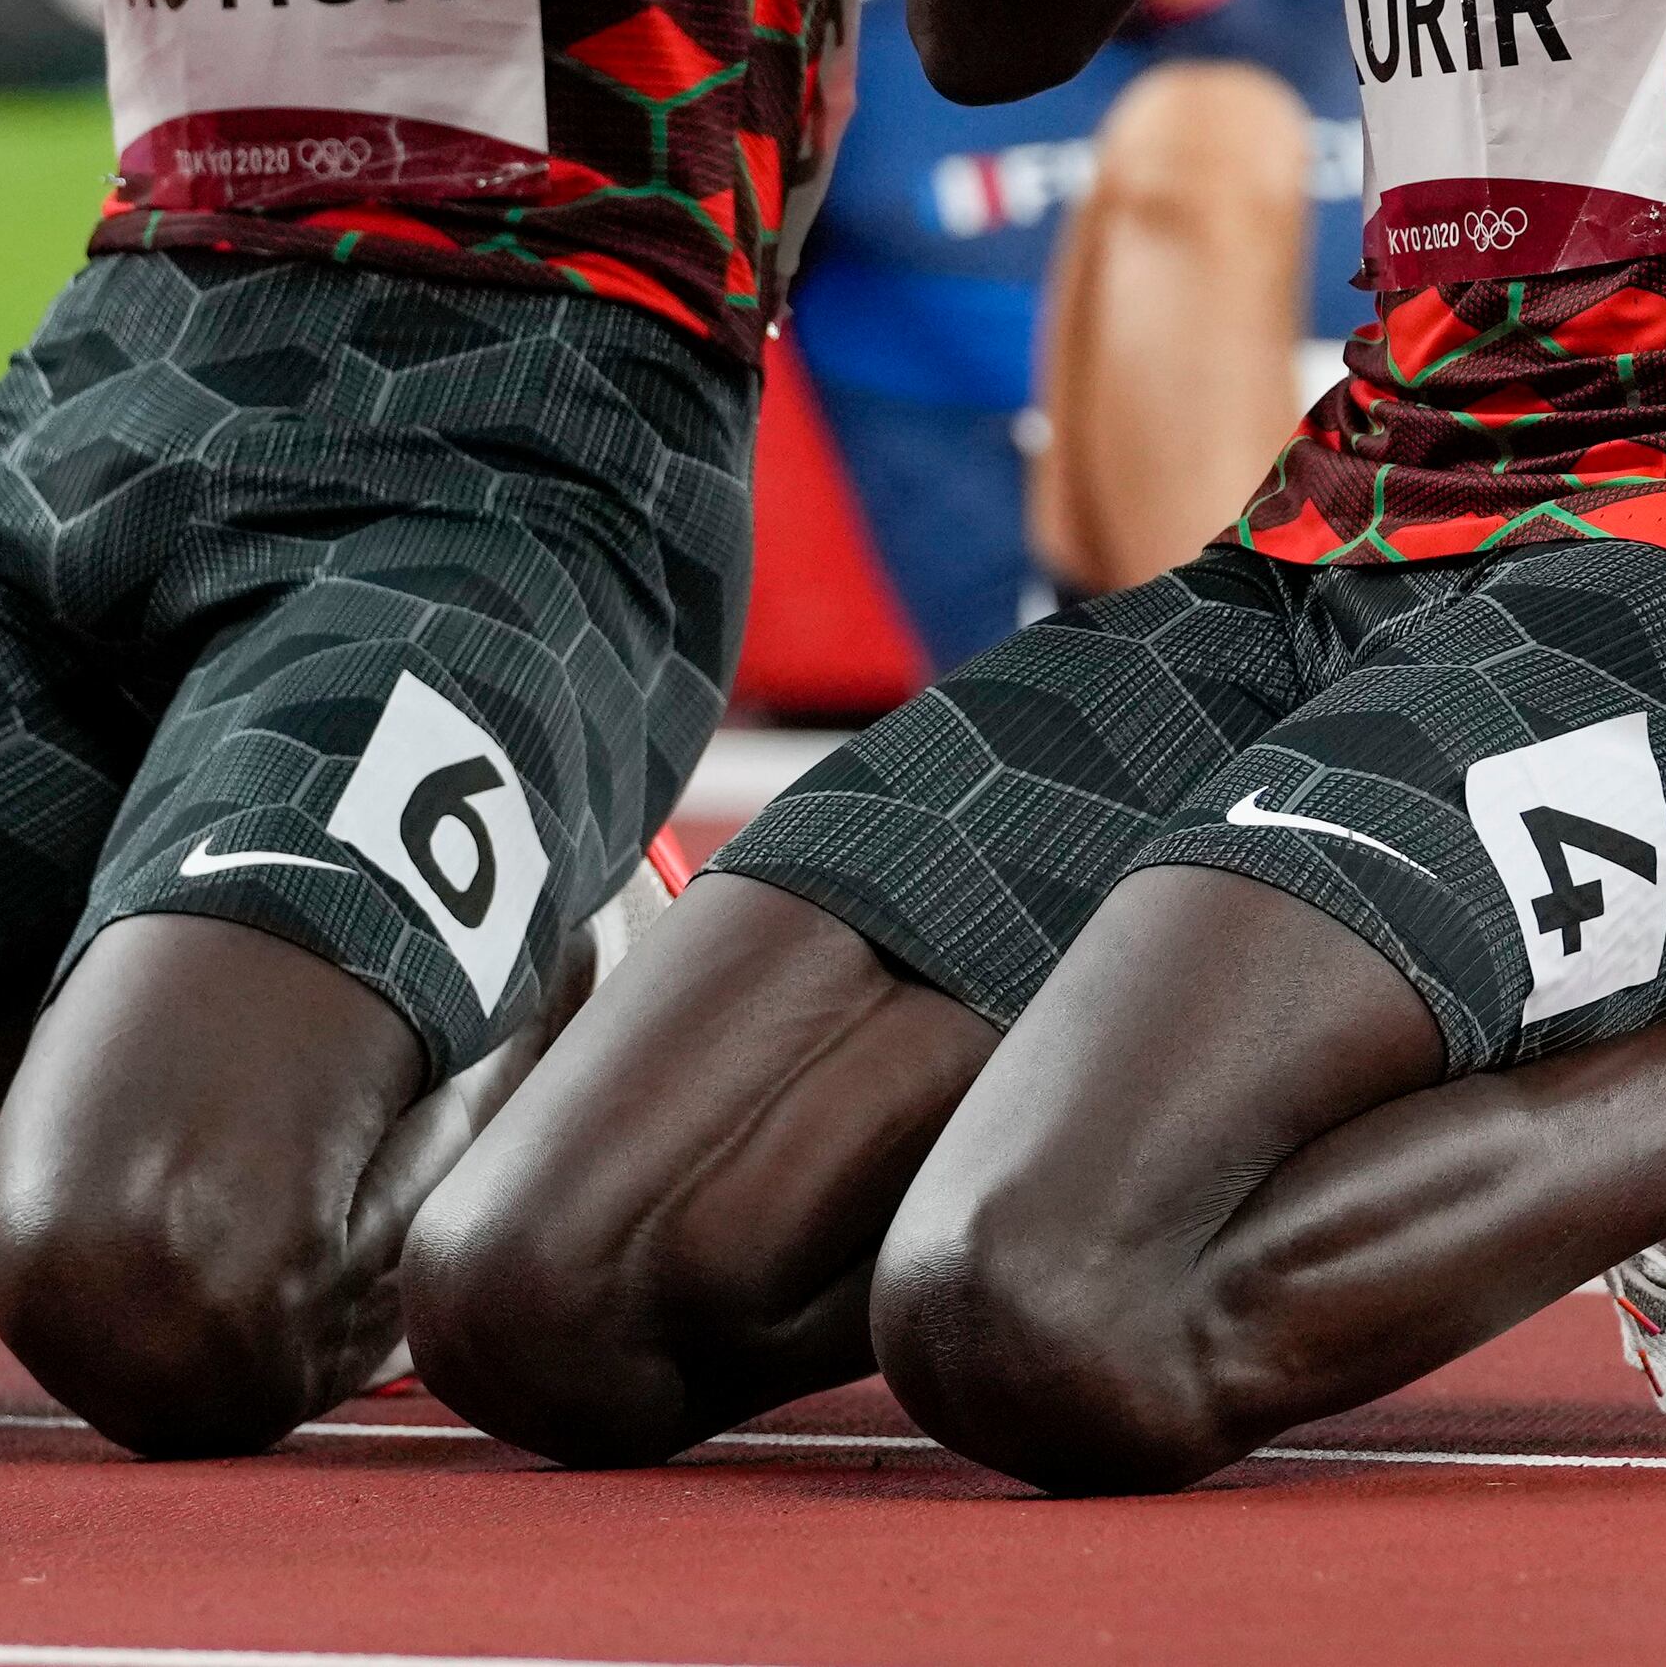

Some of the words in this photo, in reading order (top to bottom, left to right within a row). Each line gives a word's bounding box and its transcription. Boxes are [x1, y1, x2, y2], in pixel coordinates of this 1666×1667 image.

[233, 145, 291, 175] 2020
[1387, 226, 1421, 255] KYO
[1424, 221, 1460, 251] 2020
[399, 753, 506, 930] 6
[1519, 805, 1658, 958] 4
